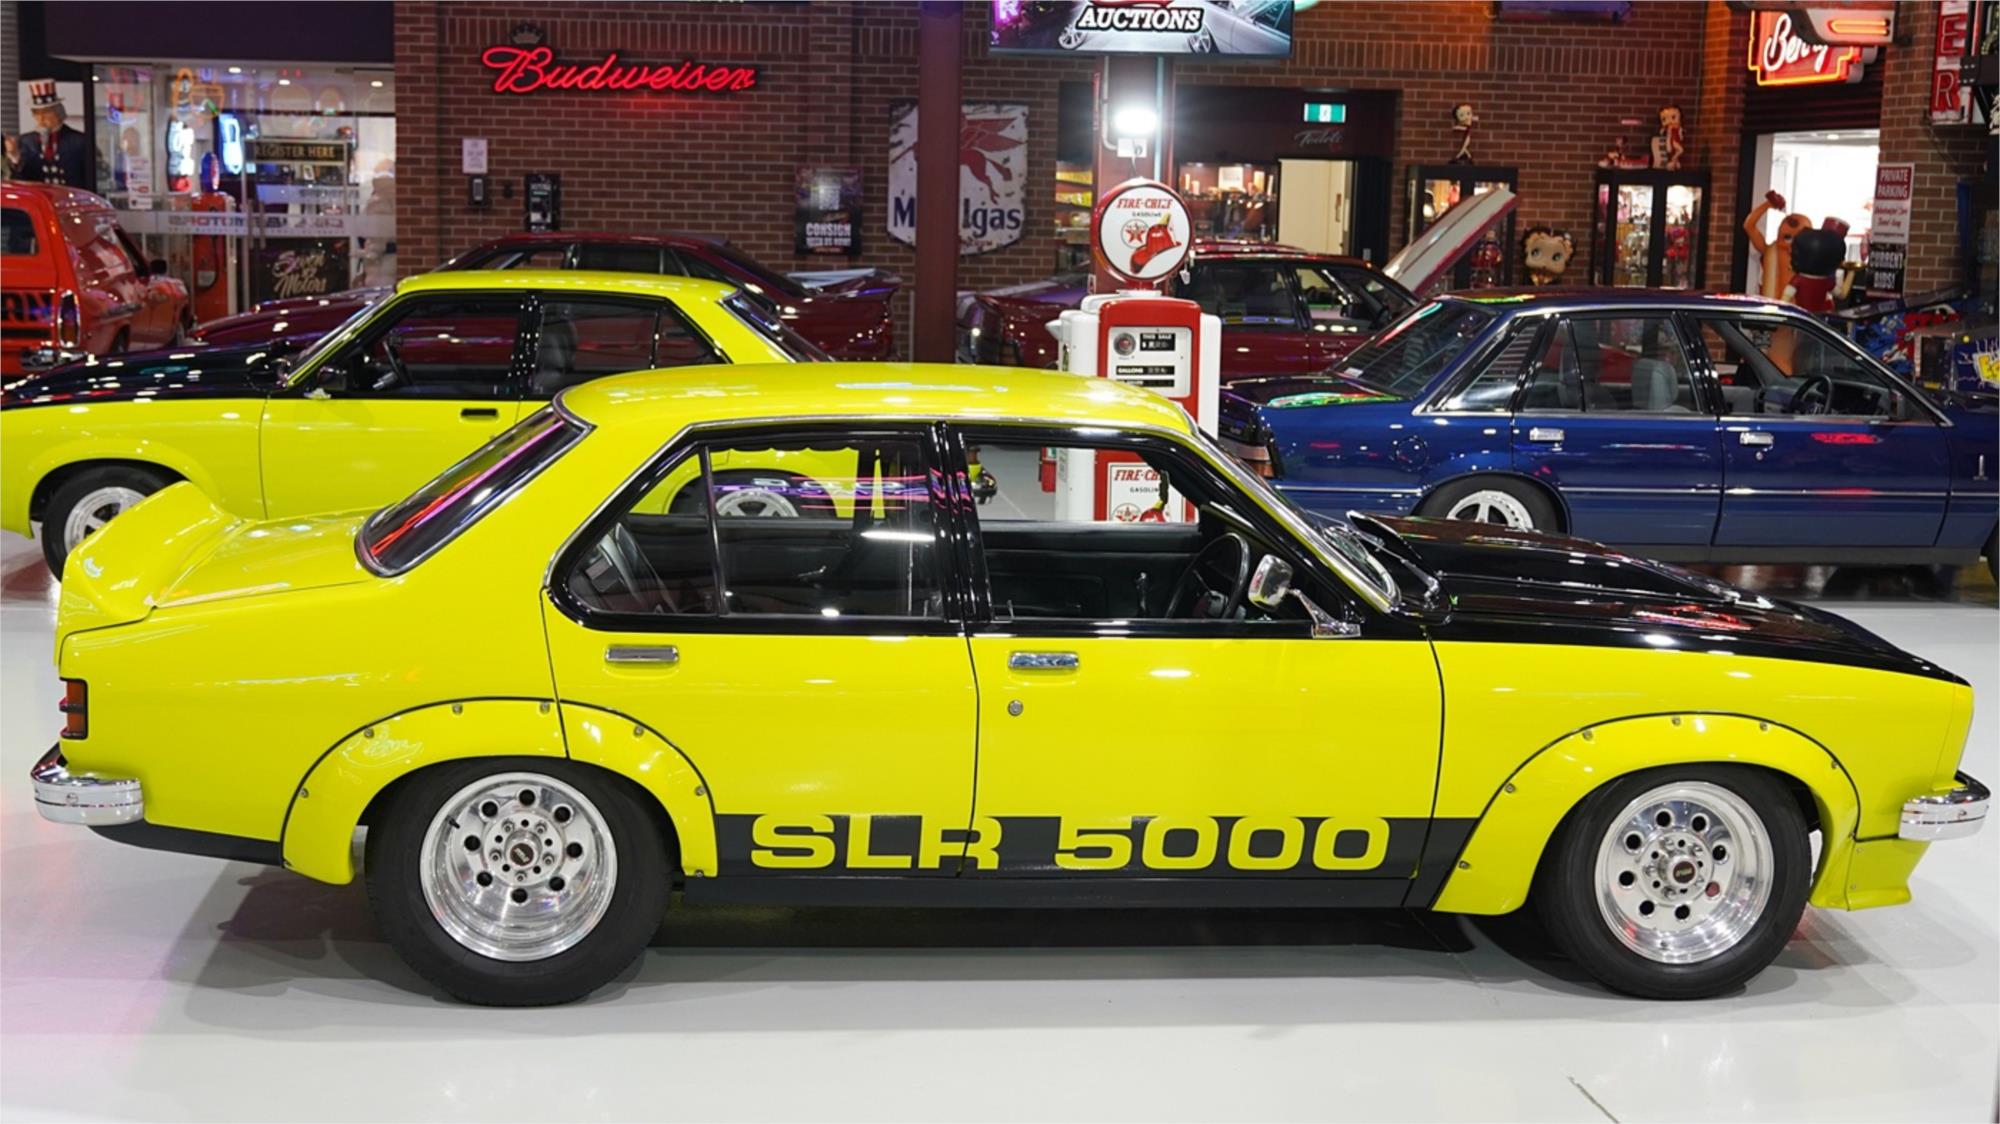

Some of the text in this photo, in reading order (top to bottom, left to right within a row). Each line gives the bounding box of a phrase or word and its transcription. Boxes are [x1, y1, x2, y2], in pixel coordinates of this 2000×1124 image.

[1078, 8, 1201, 31] AUCTIONS
[482, 46, 755, 93] Budweiser
[255, 146, 335, 158] REGISTER HERE
[1880, 169, 1908, 182] PRIVATE
[1877, 184, 1908, 198] PARKING
[805, 222, 851, 237] CONSIGN
[751, 814, 1390, 872] SLR 5000
